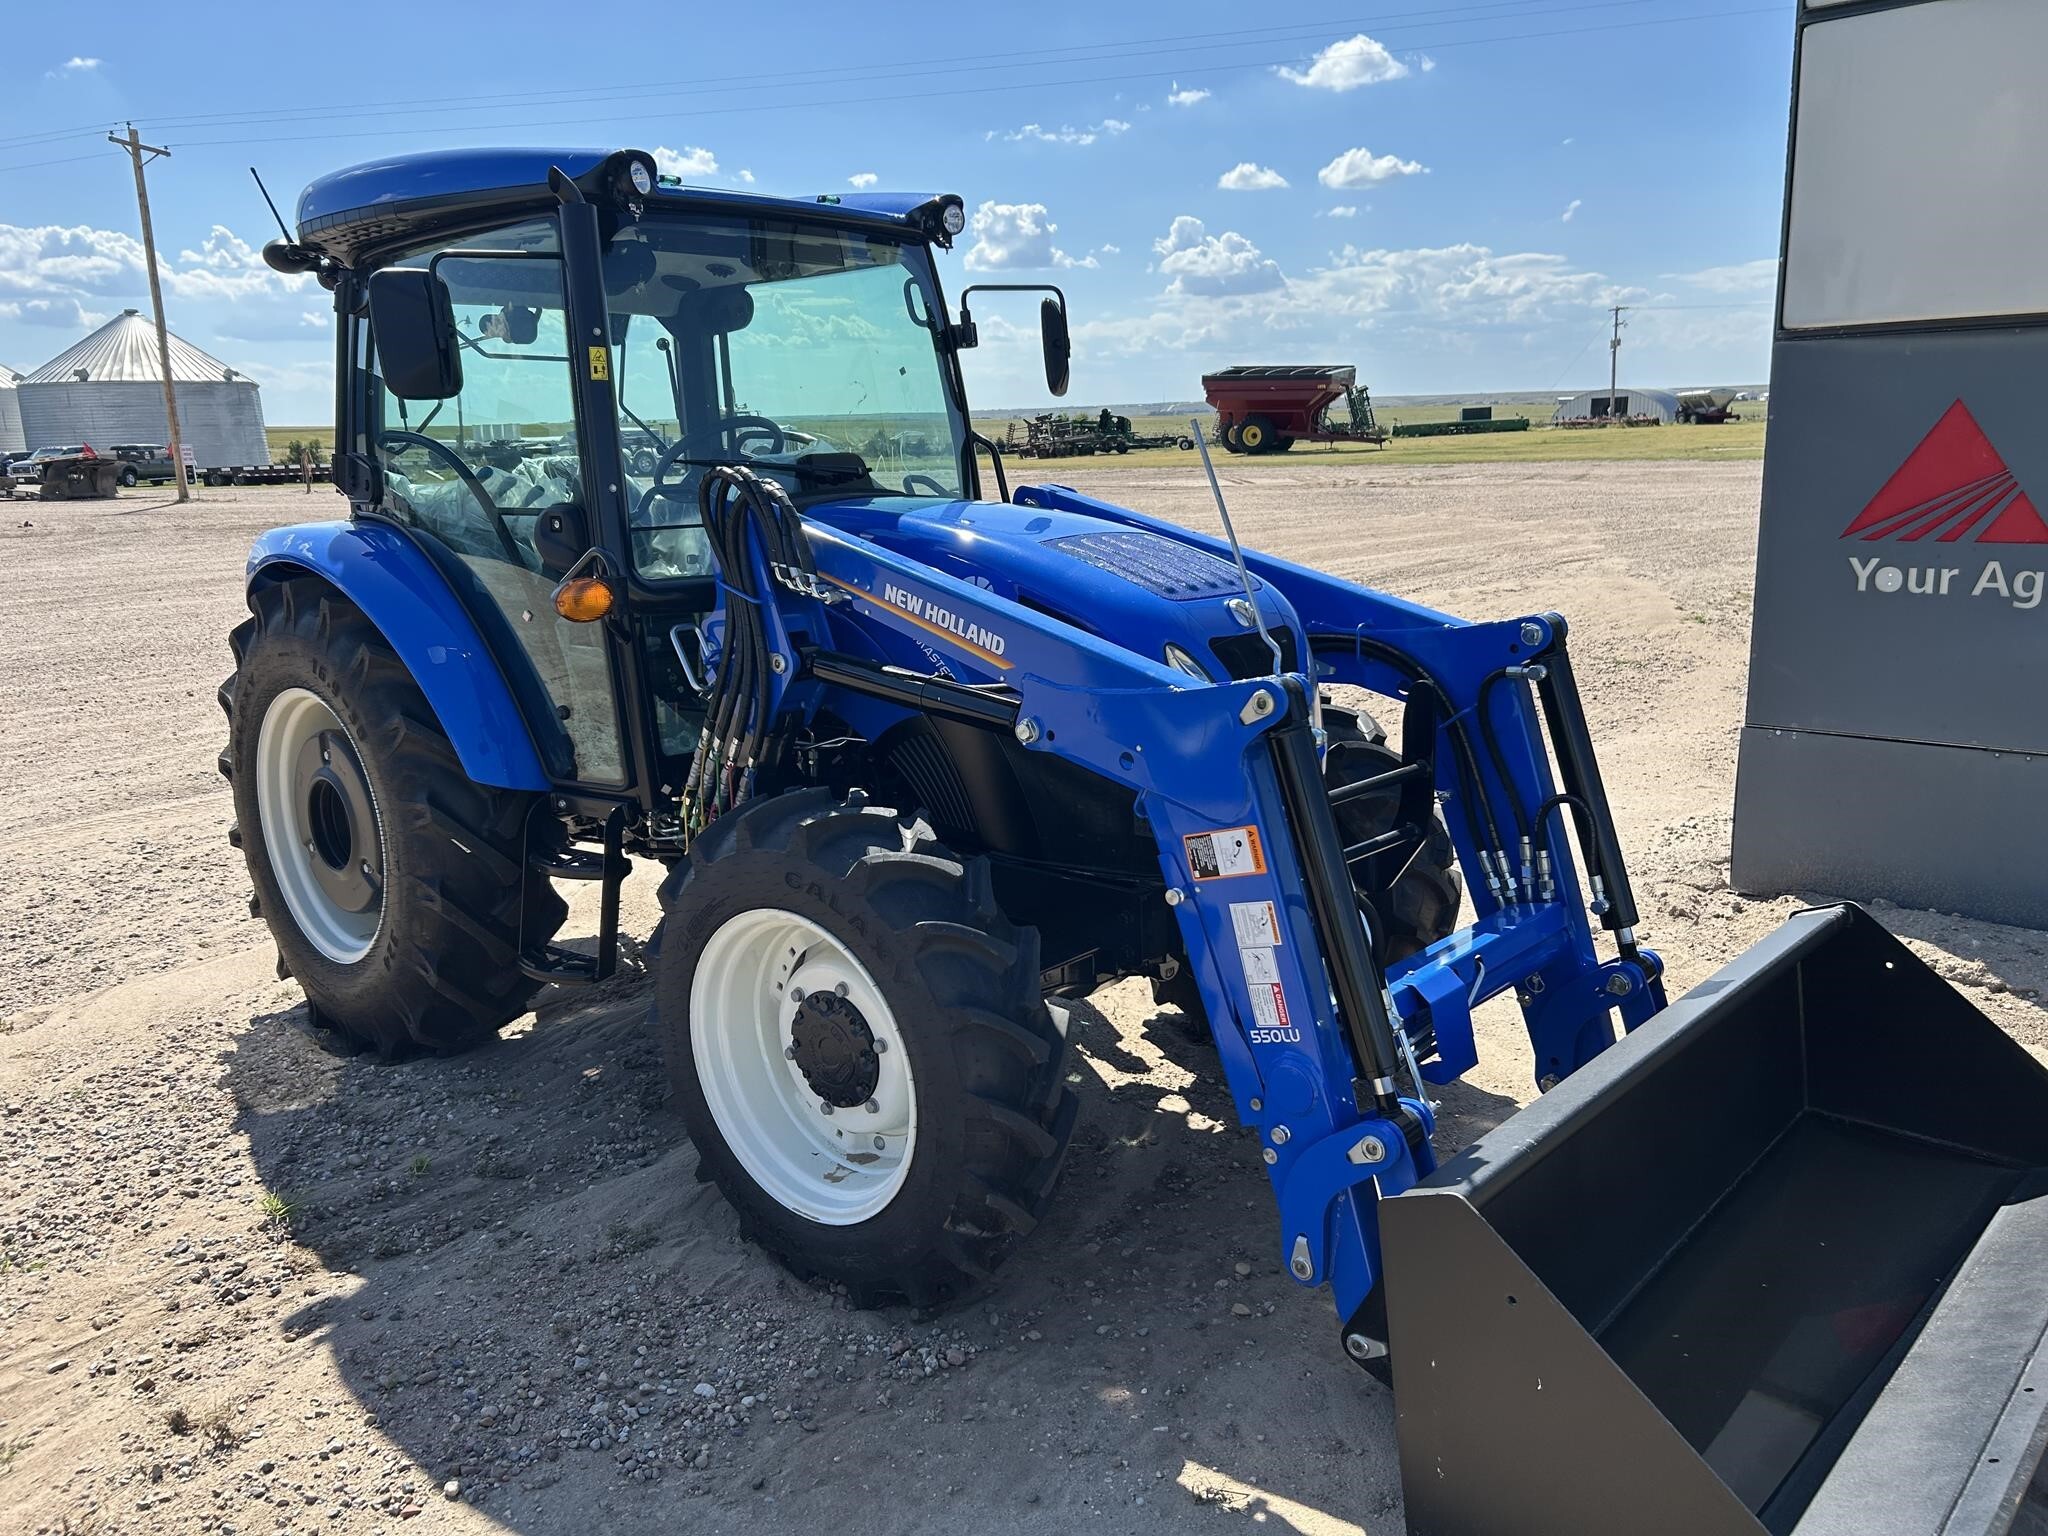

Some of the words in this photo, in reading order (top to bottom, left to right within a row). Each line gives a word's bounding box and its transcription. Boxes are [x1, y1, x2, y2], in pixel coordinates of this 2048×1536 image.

[1848, 557, 1960, 595] Your
[1971, 560, 2045, 609] Ag
[884, 583, 923, 615] NEW
[925, 602, 1006, 656] HOLLAND
[1250, 838, 1262, 869] WARNING
[1275, 993, 1287, 1023] DANGER
[1250, 1028, 1301, 1044] 550LU
